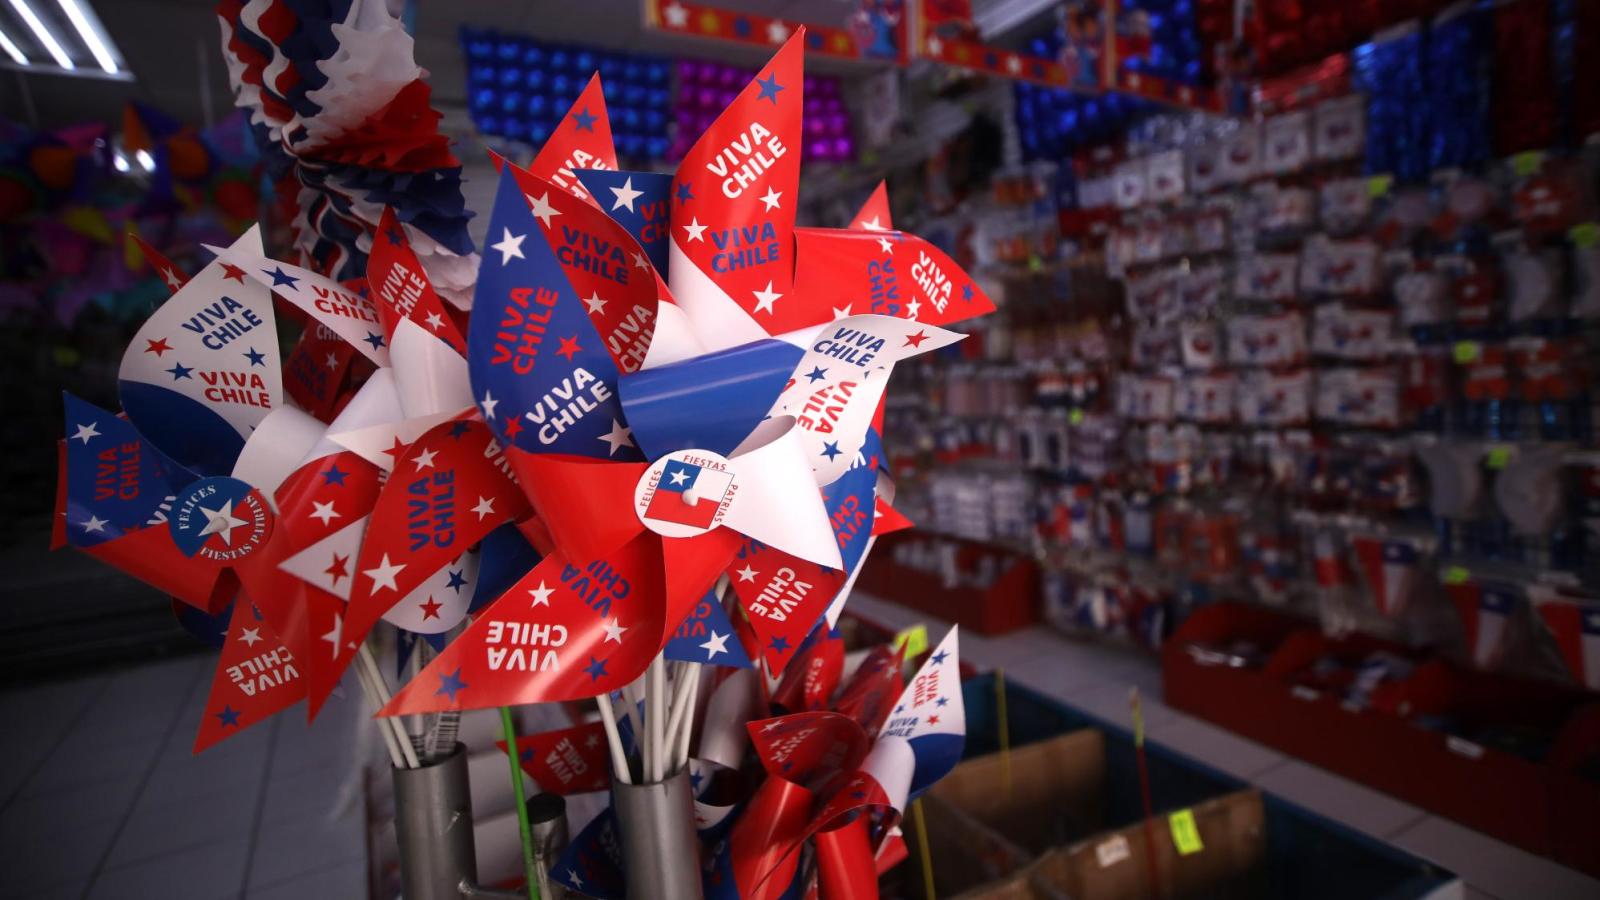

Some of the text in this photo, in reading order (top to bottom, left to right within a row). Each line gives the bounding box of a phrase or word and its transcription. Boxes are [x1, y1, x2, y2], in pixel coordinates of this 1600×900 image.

[549, 149, 593, 188] IVA
[706, 122, 771, 177] VIVA
[722, 136, 787, 199] CHILE
[562, 225, 626, 265] VIVA
[711, 222, 776, 250] VIVA
[557, 245, 629, 285] CHILE
[711, 243, 779, 273] CHILE
[919, 251, 952, 298] VIVA
[380, 262, 409, 303] VIVA
[868, 261, 885, 315] CHIL
[883, 258, 900, 316] VIVA
[911, 263, 948, 314] CHILE
[182, 295, 243, 335] VIVA
[202, 308, 263, 351] CHILE
[491, 287, 534, 365] VIVA
[512, 287, 559, 375] CHILE
[608, 304, 653, 355] VIVA
[813, 340, 875, 367] CHILE
[834, 328, 885, 352] VIVA
[199, 371, 266, 390] VIVA
[204, 387, 271, 409] CHILE
[525, 367, 595, 424] VIVA
[538, 380, 612, 445] CHILE
[815, 381, 857, 433] VIVA
[96, 448, 117, 500] VIVA
[119, 440, 141, 500] CHILE
[640, 454, 739, 522] FELICES FIESTAS PATRIAS
[407, 476, 431, 551] VIVA
[433, 469, 455, 548] CHILE
[829, 495, 860, 530] CHI
[837, 511, 867, 550] VIV
[560, 562, 612, 618] VIVA
[749, 567, 796, 617] CHILE
[768, 580, 813, 622] VIVA
[486, 620, 568, 647] CHILE
[226, 646, 294, 683] CHILE
[238, 663, 300, 697] VIVA
[487, 647, 561, 672] VIVA
[913, 675, 927, 709] CHILE
[926, 670, 939, 701] VIVA
